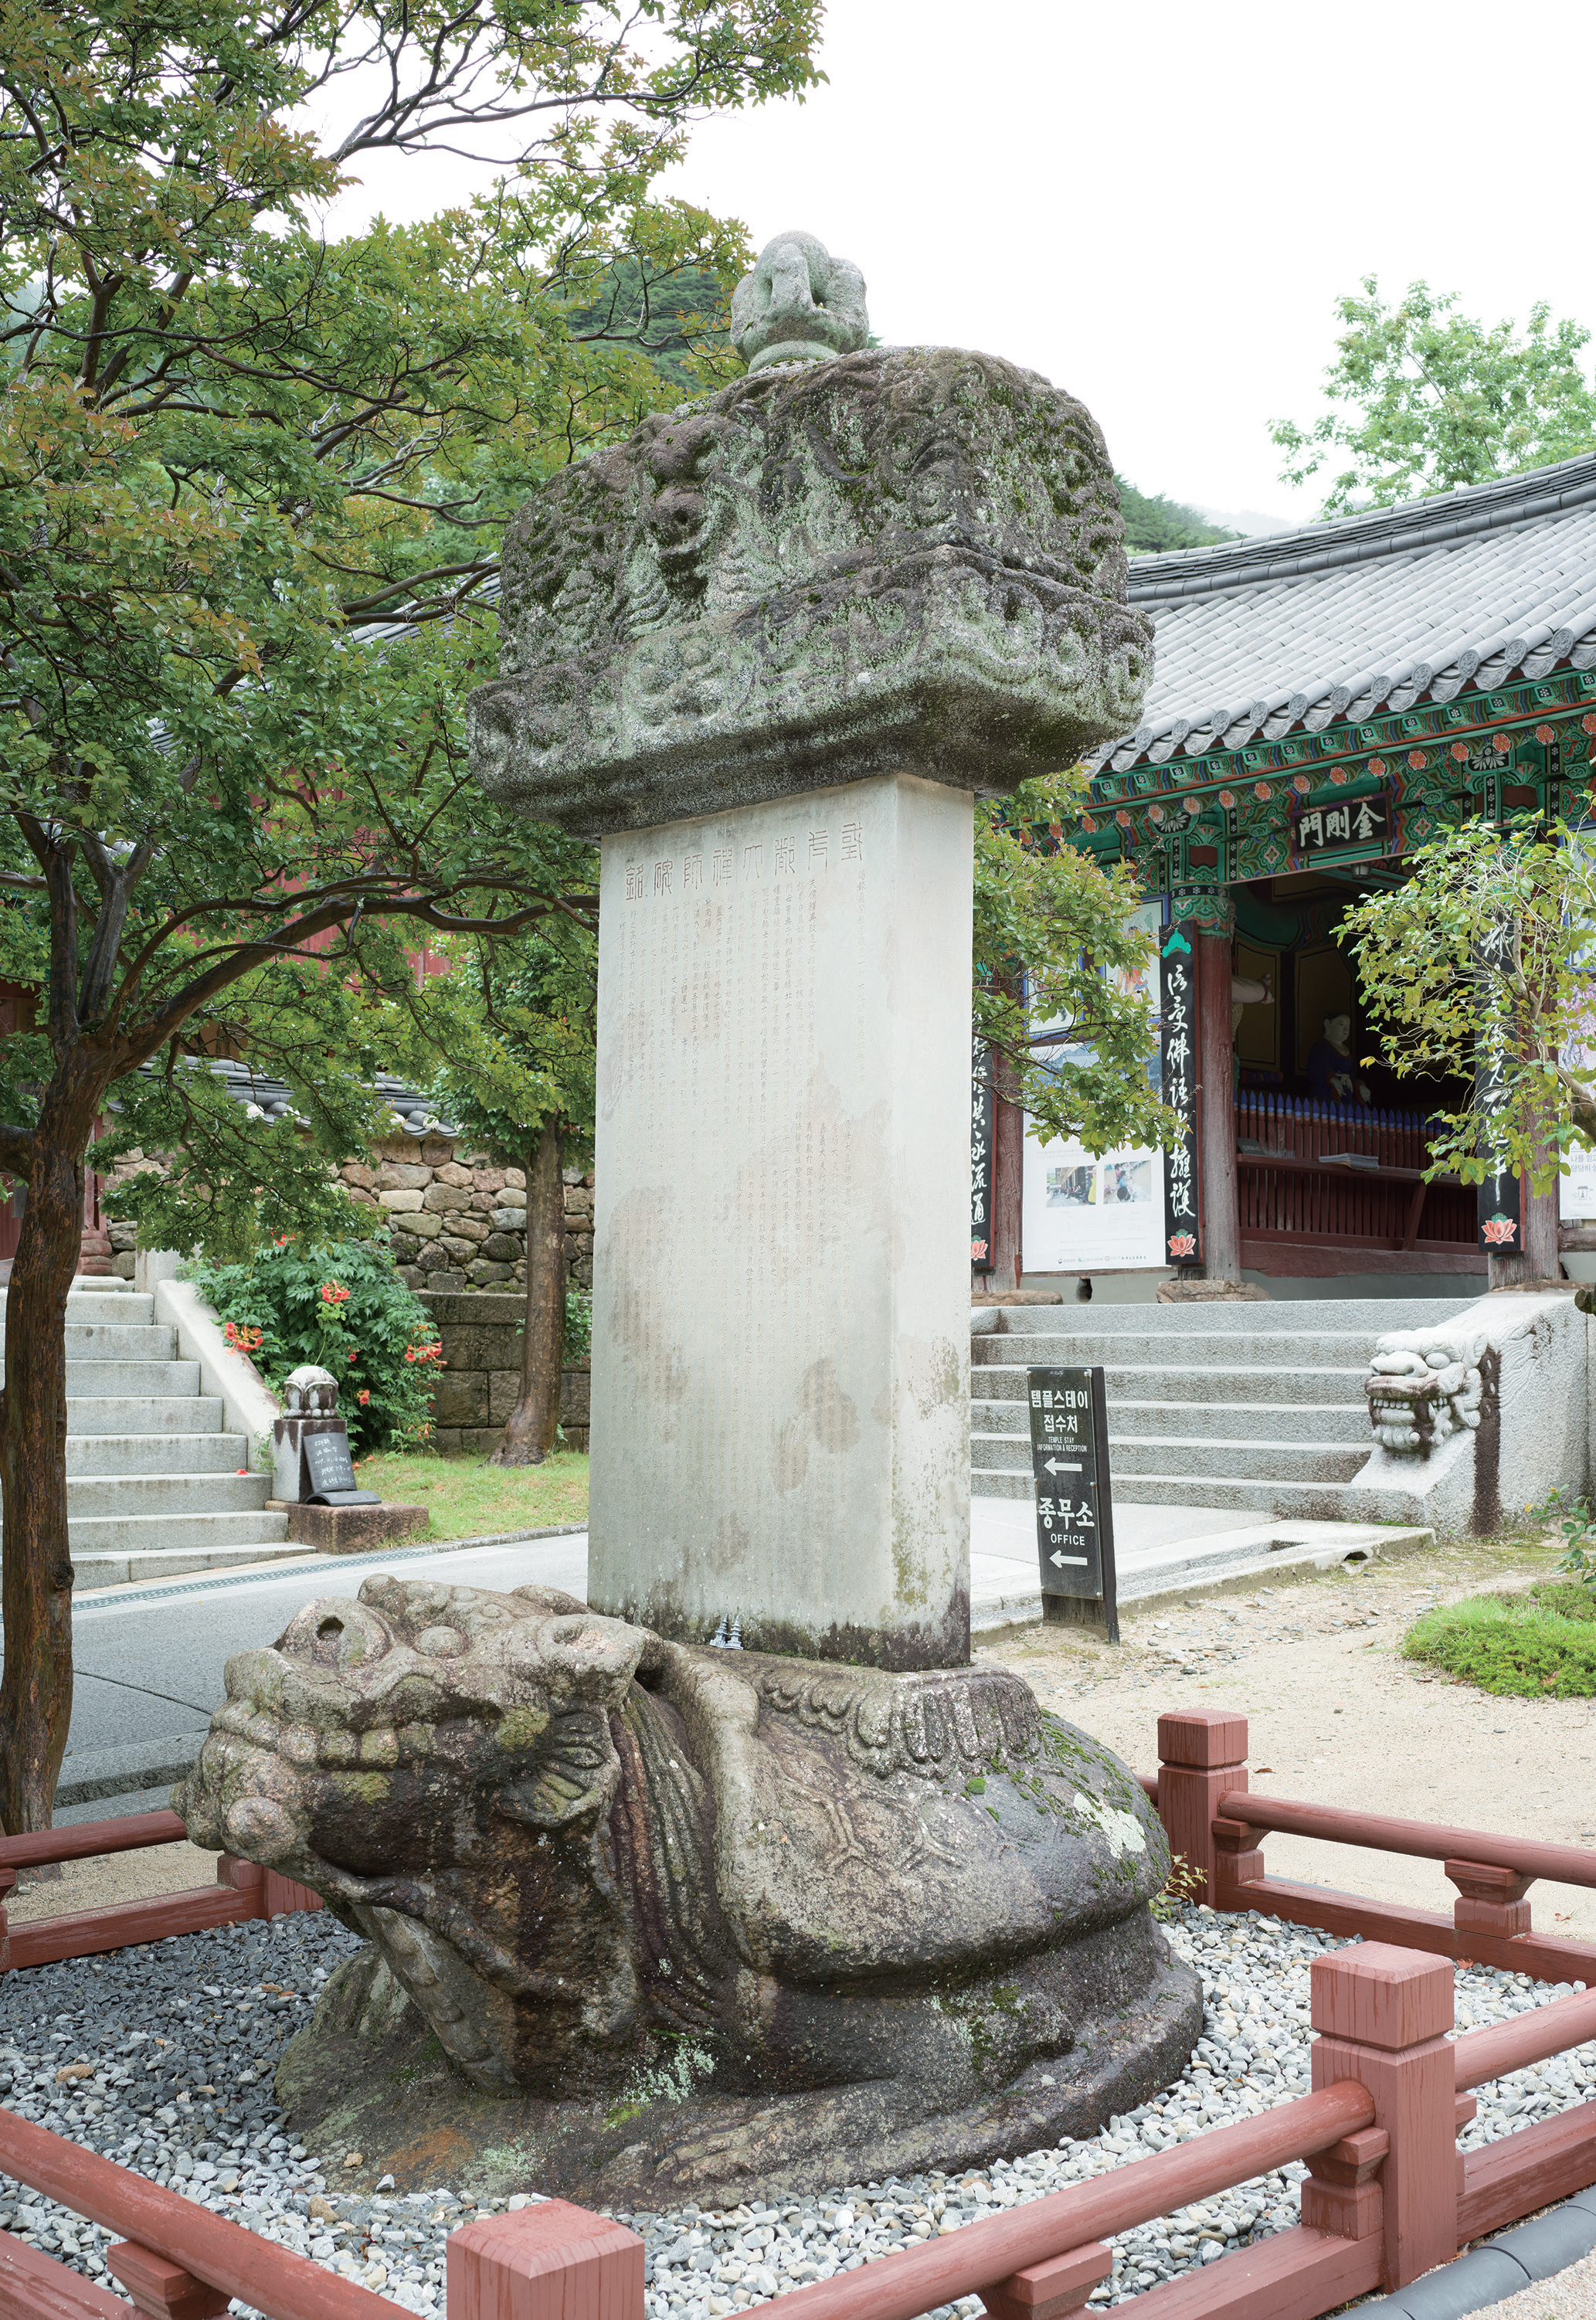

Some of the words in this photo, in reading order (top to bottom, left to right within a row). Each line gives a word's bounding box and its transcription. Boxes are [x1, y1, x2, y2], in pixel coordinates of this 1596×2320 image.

[1299, 802, 1386, 847] 金剛門
[970, 1009, 988, 1226] 行經典永流通
[1031, 1390, 1088, 1409] 템플스테이
[1044, 1414, 1078, 1433] 접수처
[1037, 1443, 1062, 1452] INFORMATION
[1038, 1497, 1095, 1530] 종무소
[1051, 1533, 1085, 1546] OFFICE
